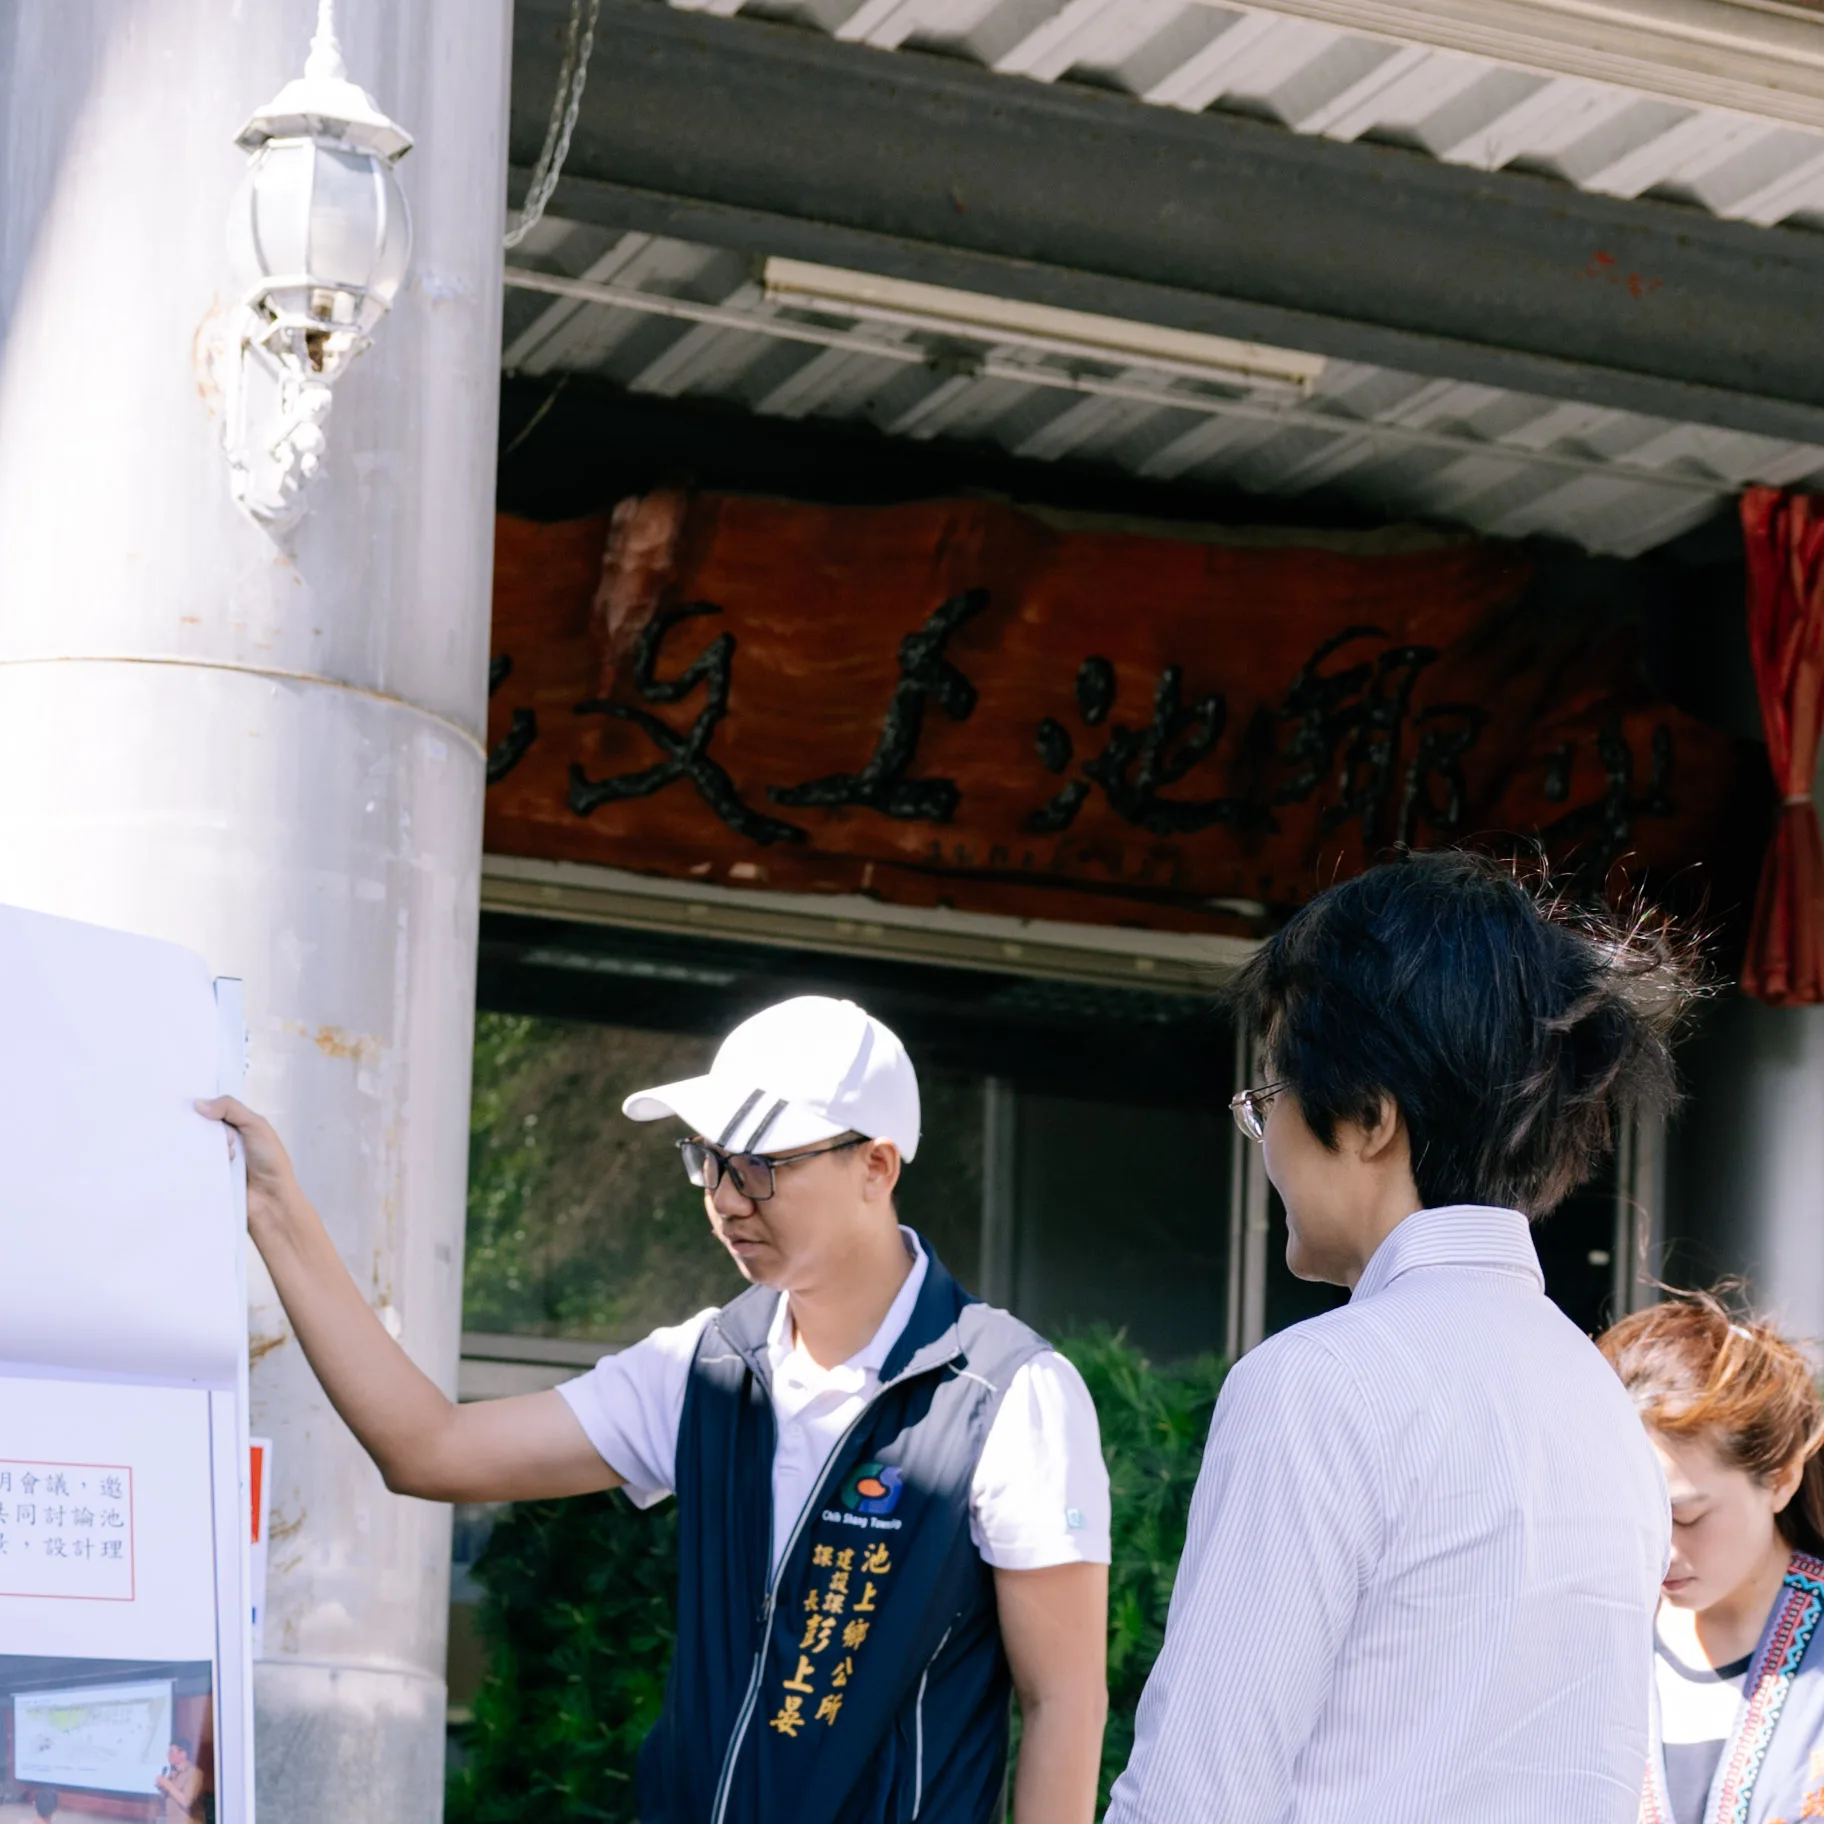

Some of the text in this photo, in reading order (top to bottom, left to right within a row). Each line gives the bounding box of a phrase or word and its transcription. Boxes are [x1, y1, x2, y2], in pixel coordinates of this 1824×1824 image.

[814, 1542, 891, 1727] 池上鄉公所
